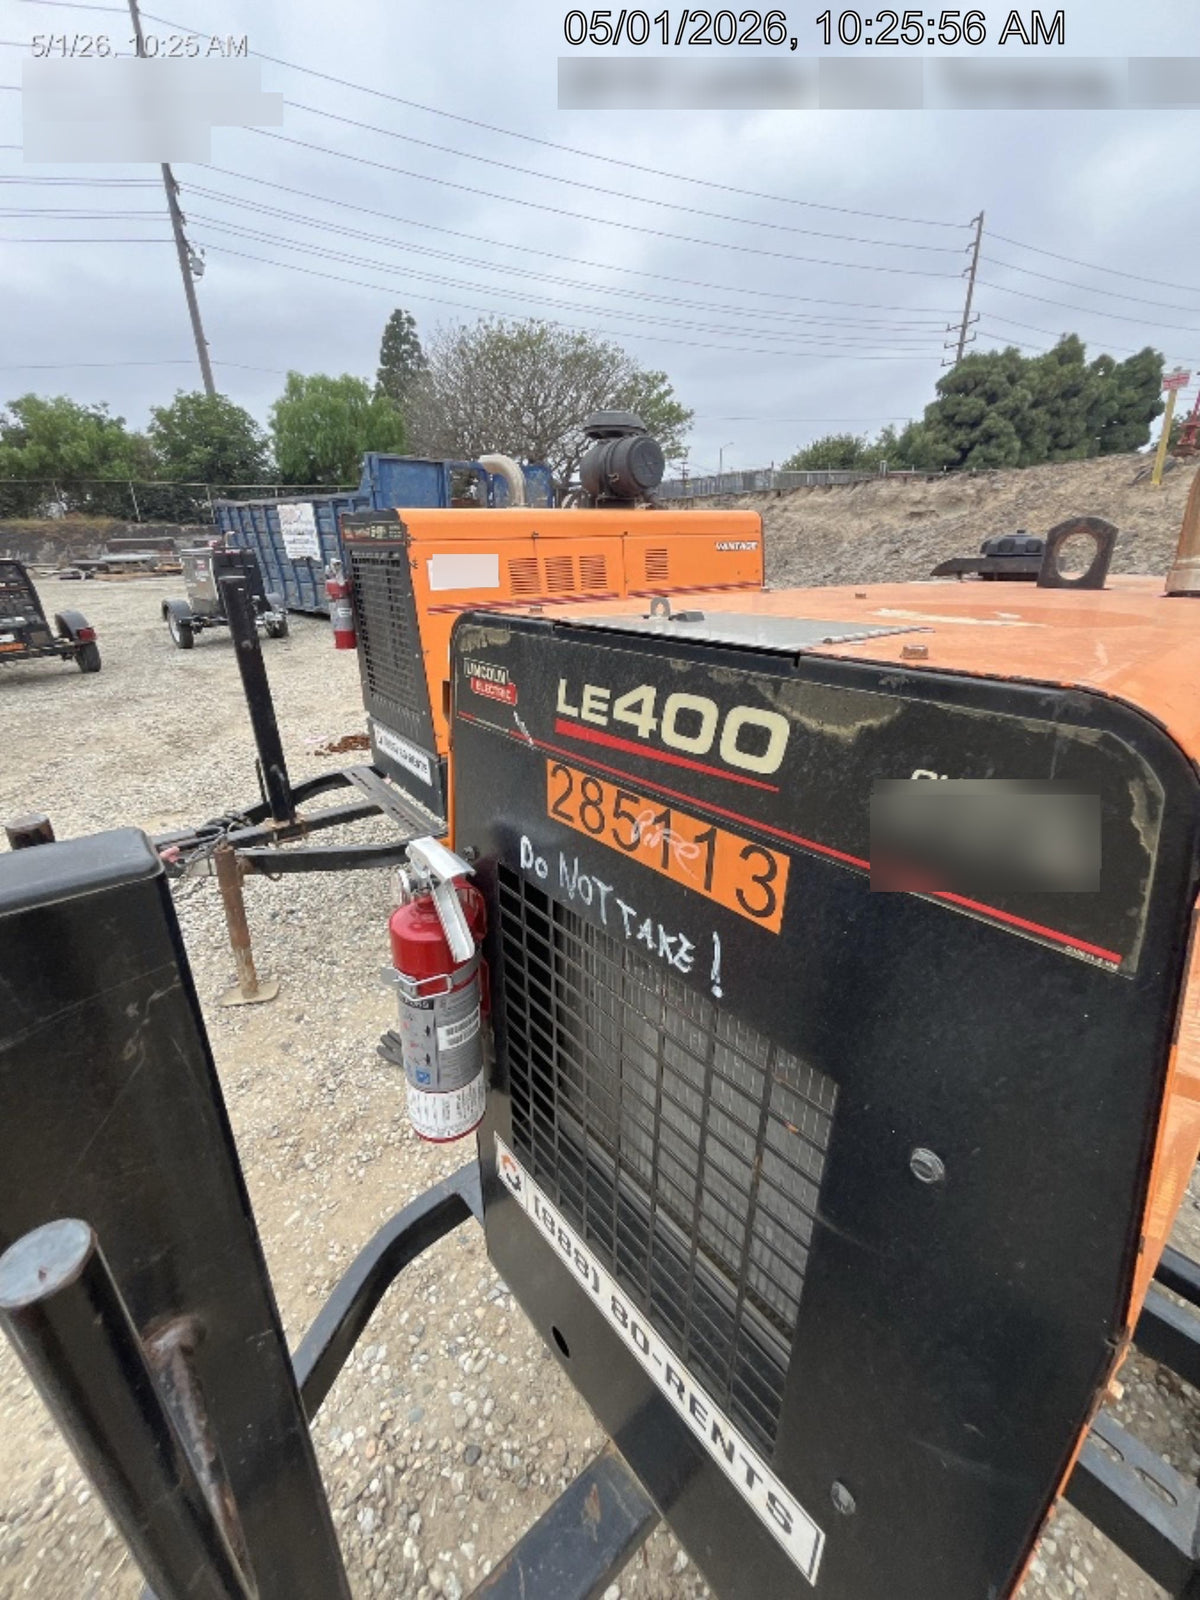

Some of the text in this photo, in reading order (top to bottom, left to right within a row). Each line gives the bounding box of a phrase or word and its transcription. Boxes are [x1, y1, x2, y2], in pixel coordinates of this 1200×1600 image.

[465, 659, 508, 685] LINCOLN
[475, 680, 512, 700] ELECTRIC
[555, 678, 790, 775] LE400
[550, 764, 779, 918] 285113
[520, 835, 548, 879] Do
[559, 851, 614, 925] NOT
[616, 898, 697, 973] TAKE
[610, 1294, 793, 1536] 80-RENTS
